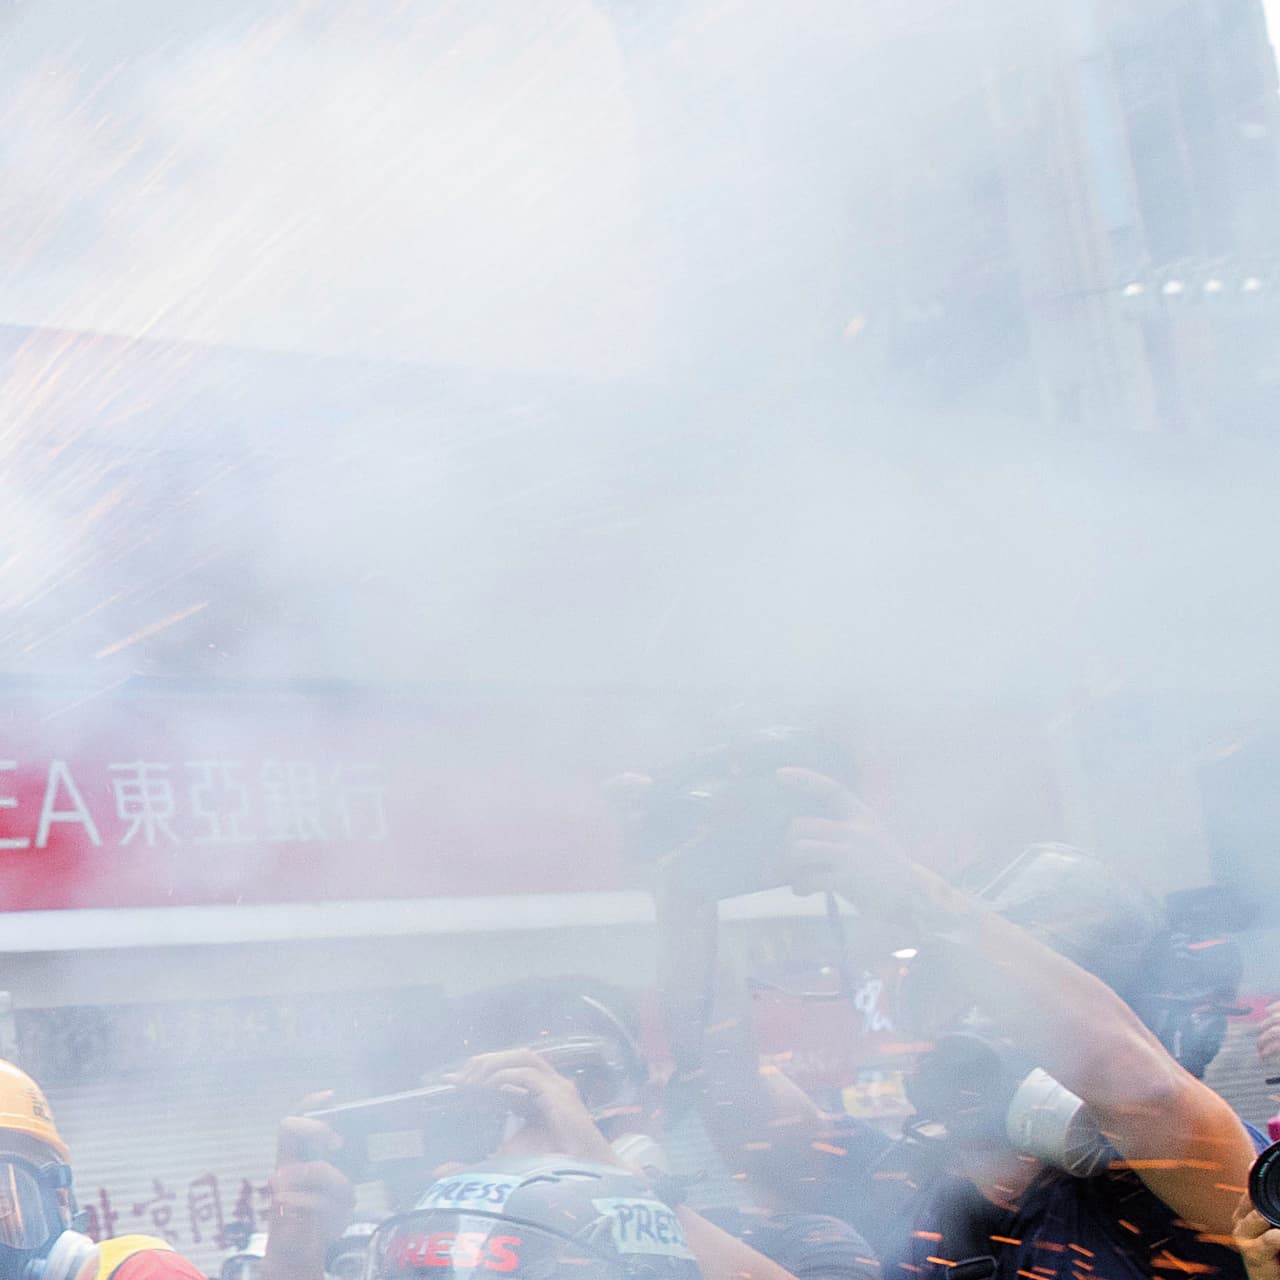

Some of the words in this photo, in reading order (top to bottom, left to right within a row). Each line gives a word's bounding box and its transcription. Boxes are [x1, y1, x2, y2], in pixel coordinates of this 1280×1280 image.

[108, 759, 390, 847] 東亞銀行
[425, 1178, 513, 1206] PRESS
